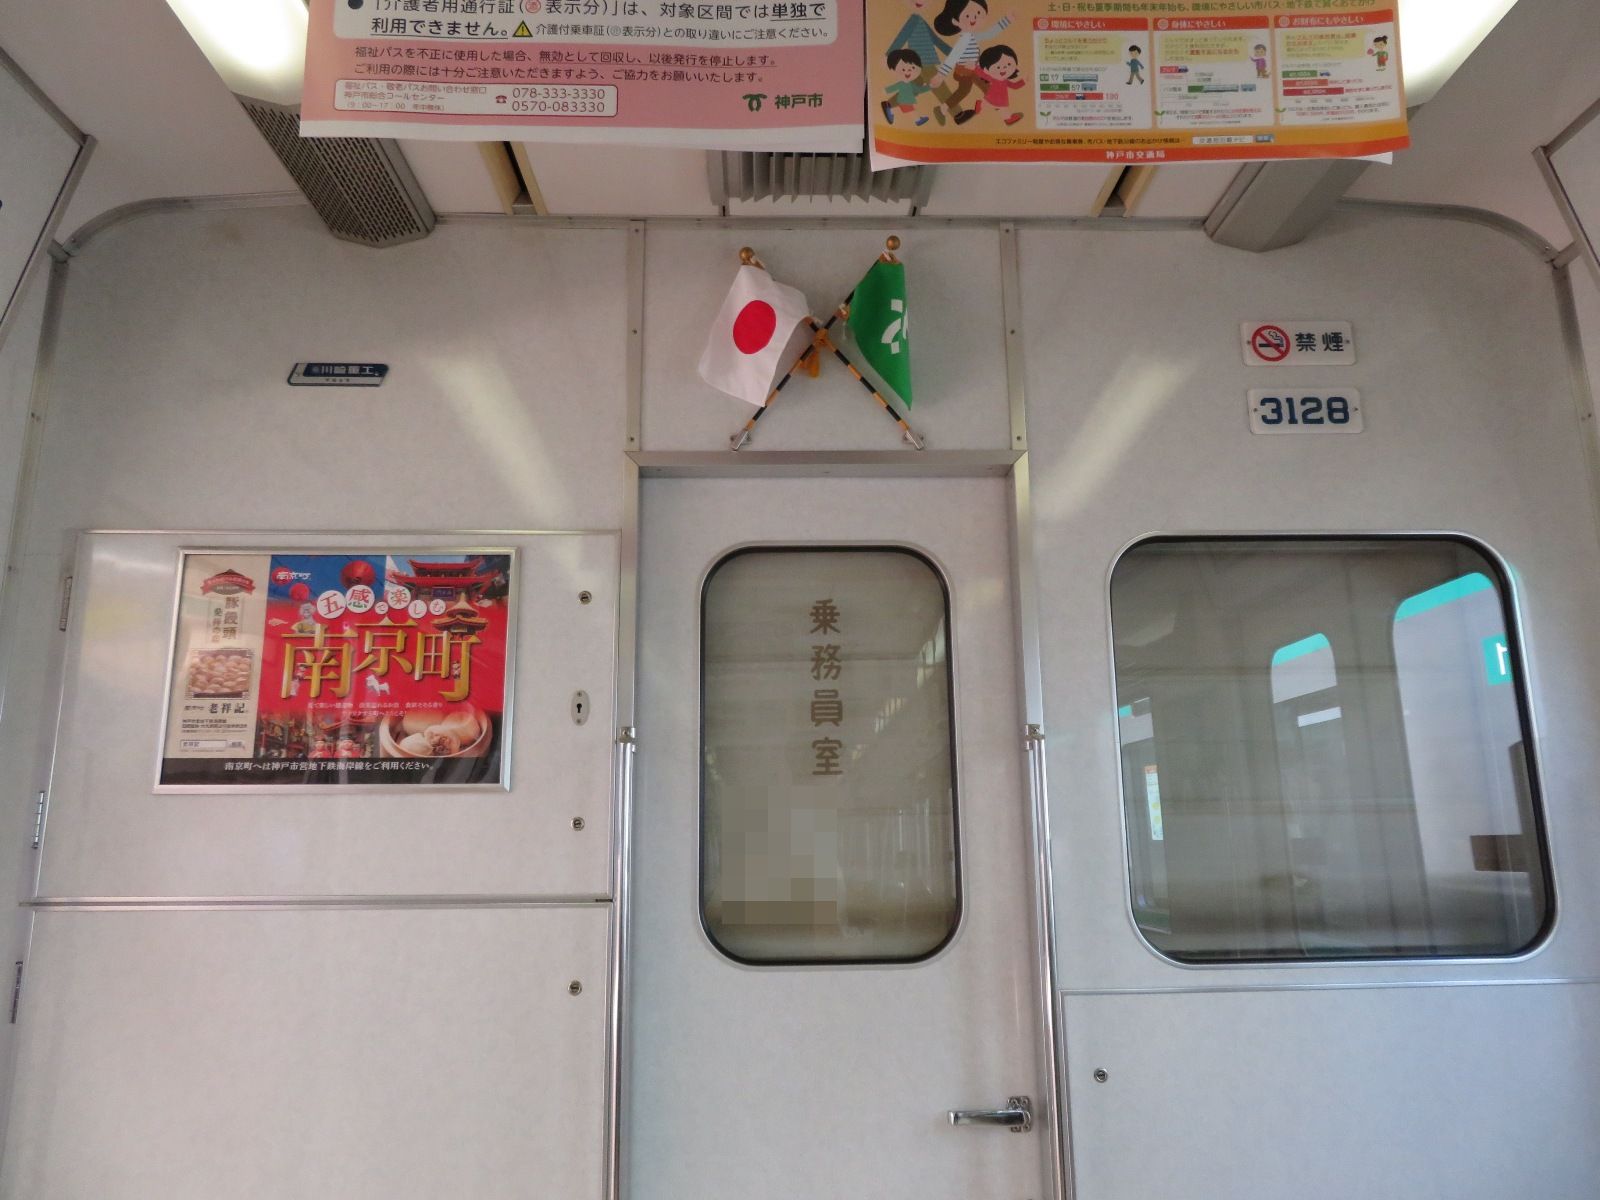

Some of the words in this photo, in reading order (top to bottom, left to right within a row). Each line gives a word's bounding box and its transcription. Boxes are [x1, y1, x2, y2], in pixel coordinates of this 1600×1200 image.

[371, 17, 508, 37] 利用できません。
[512, 87, 606, 100] 078-333-3330
[774, 92, 824, 110] 神戸市
[511, 100, 605, 113] 0570-083330
[1105, 150, 1166, 160] 神戸市交通局
[1295, 332, 1345, 352] 禁煙
[1260, 396, 1350, 425] 3128
[281, 616, 482, 702] 南京町
[809, 599, 844, 776] 乗務員室
[224, 761, 434, 772] 南京町へは神戸市営地下鉄海岸線をご利用ください。
